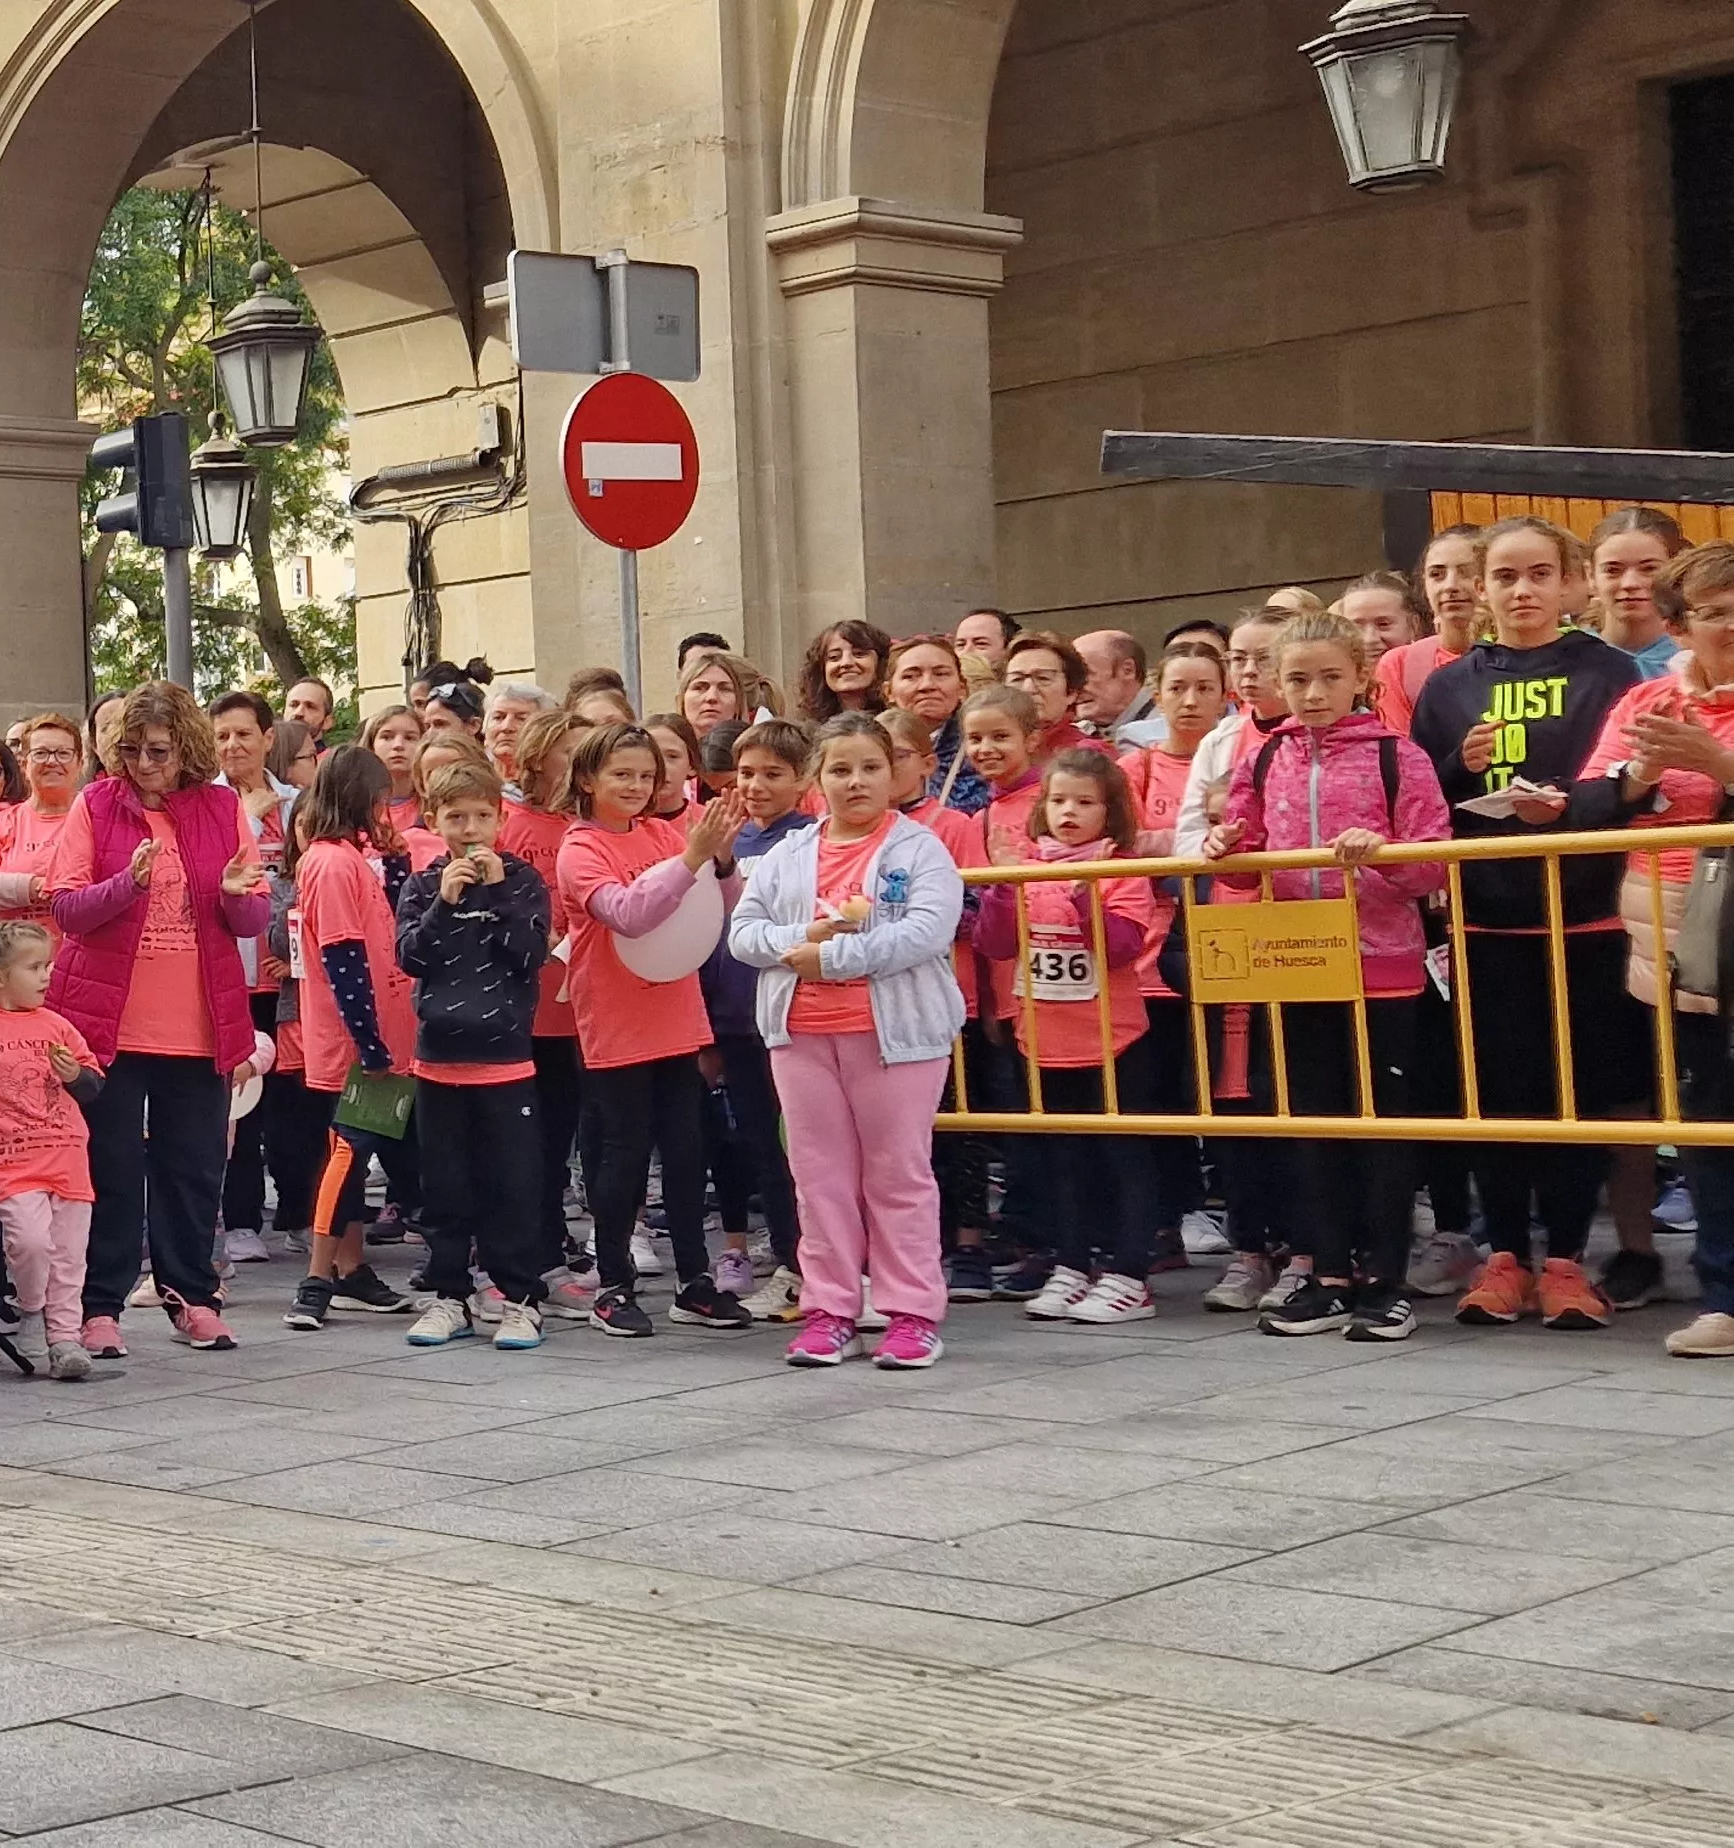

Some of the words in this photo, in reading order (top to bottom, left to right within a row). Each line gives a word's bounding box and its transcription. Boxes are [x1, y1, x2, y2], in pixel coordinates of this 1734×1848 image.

[1482, 677, 1568, 722] JUST
[1252, 935, 1347, 952] Ayuntamiento
[1029, 951, 1088, 982] 436
[1253, 956, 1271, 968] de
[1274, 955, 1327, 968] Huesca
